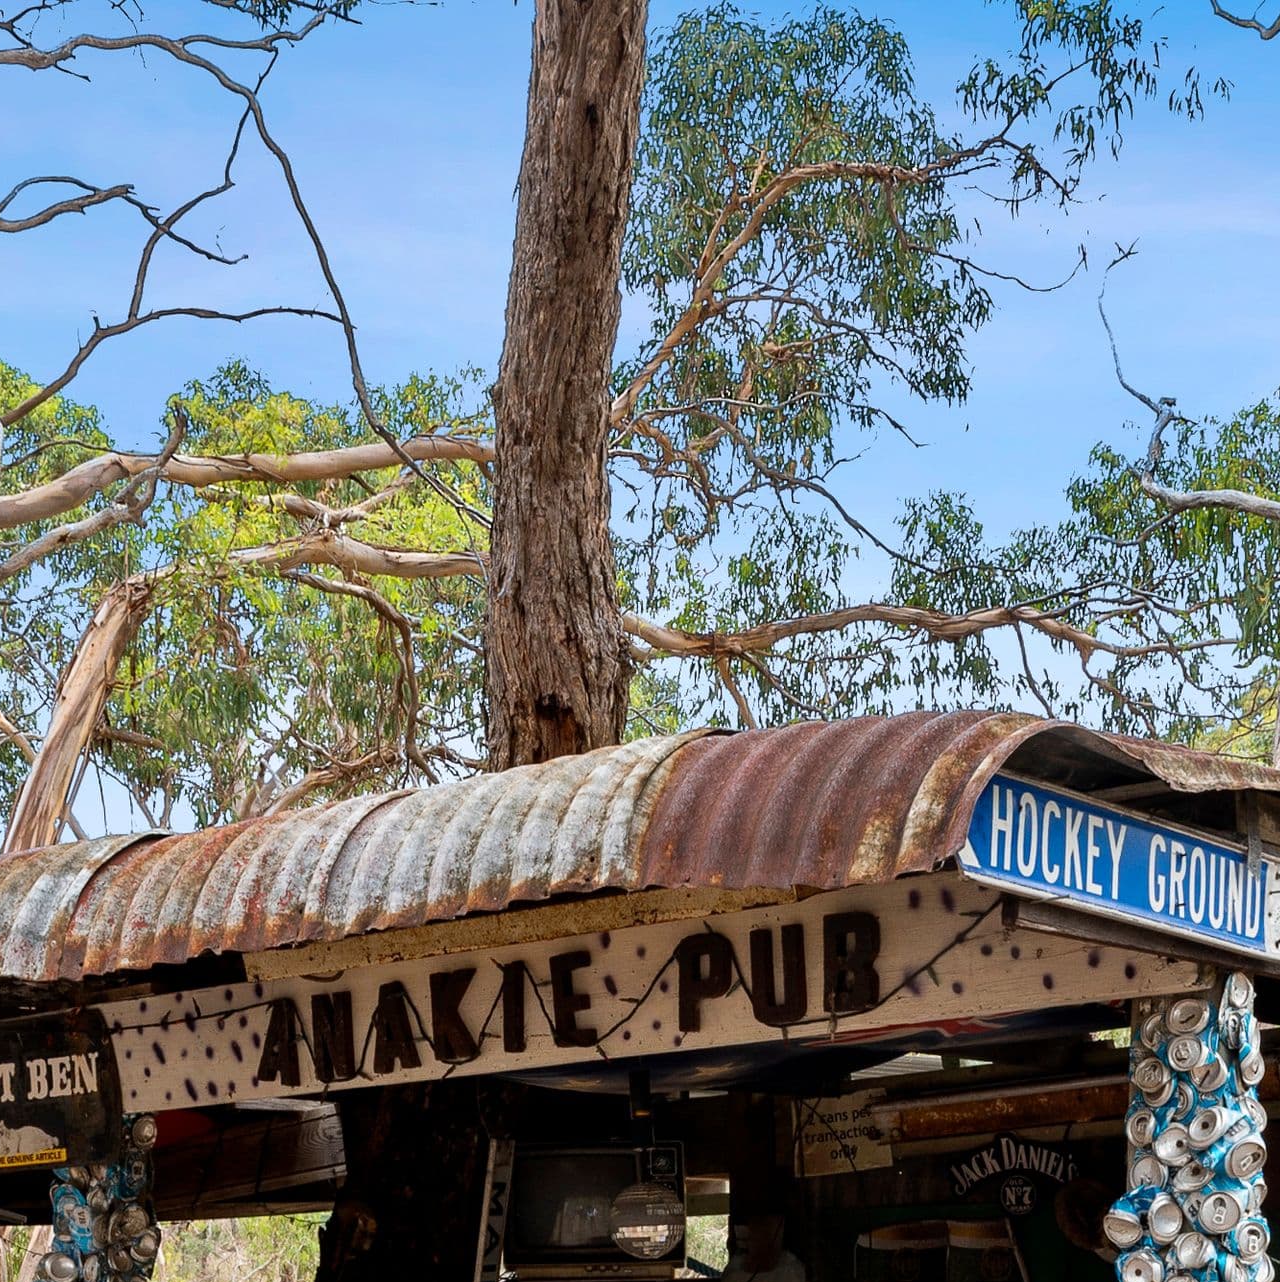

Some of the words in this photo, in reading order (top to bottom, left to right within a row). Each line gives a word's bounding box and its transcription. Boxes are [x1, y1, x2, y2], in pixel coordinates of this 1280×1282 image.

[990, 784, 1127, 899] HOCKEY
[1148, 834, 1261, 938] GROUND
[257, 950, 598, 1086] ANAKIE
[676, 911, 881, 1032] PUB
[26, 1051, 99, 1101] BEN
[6, 1153, 34, 1163] GENUINE
[948, 1147, 1001, 1197] JACK
